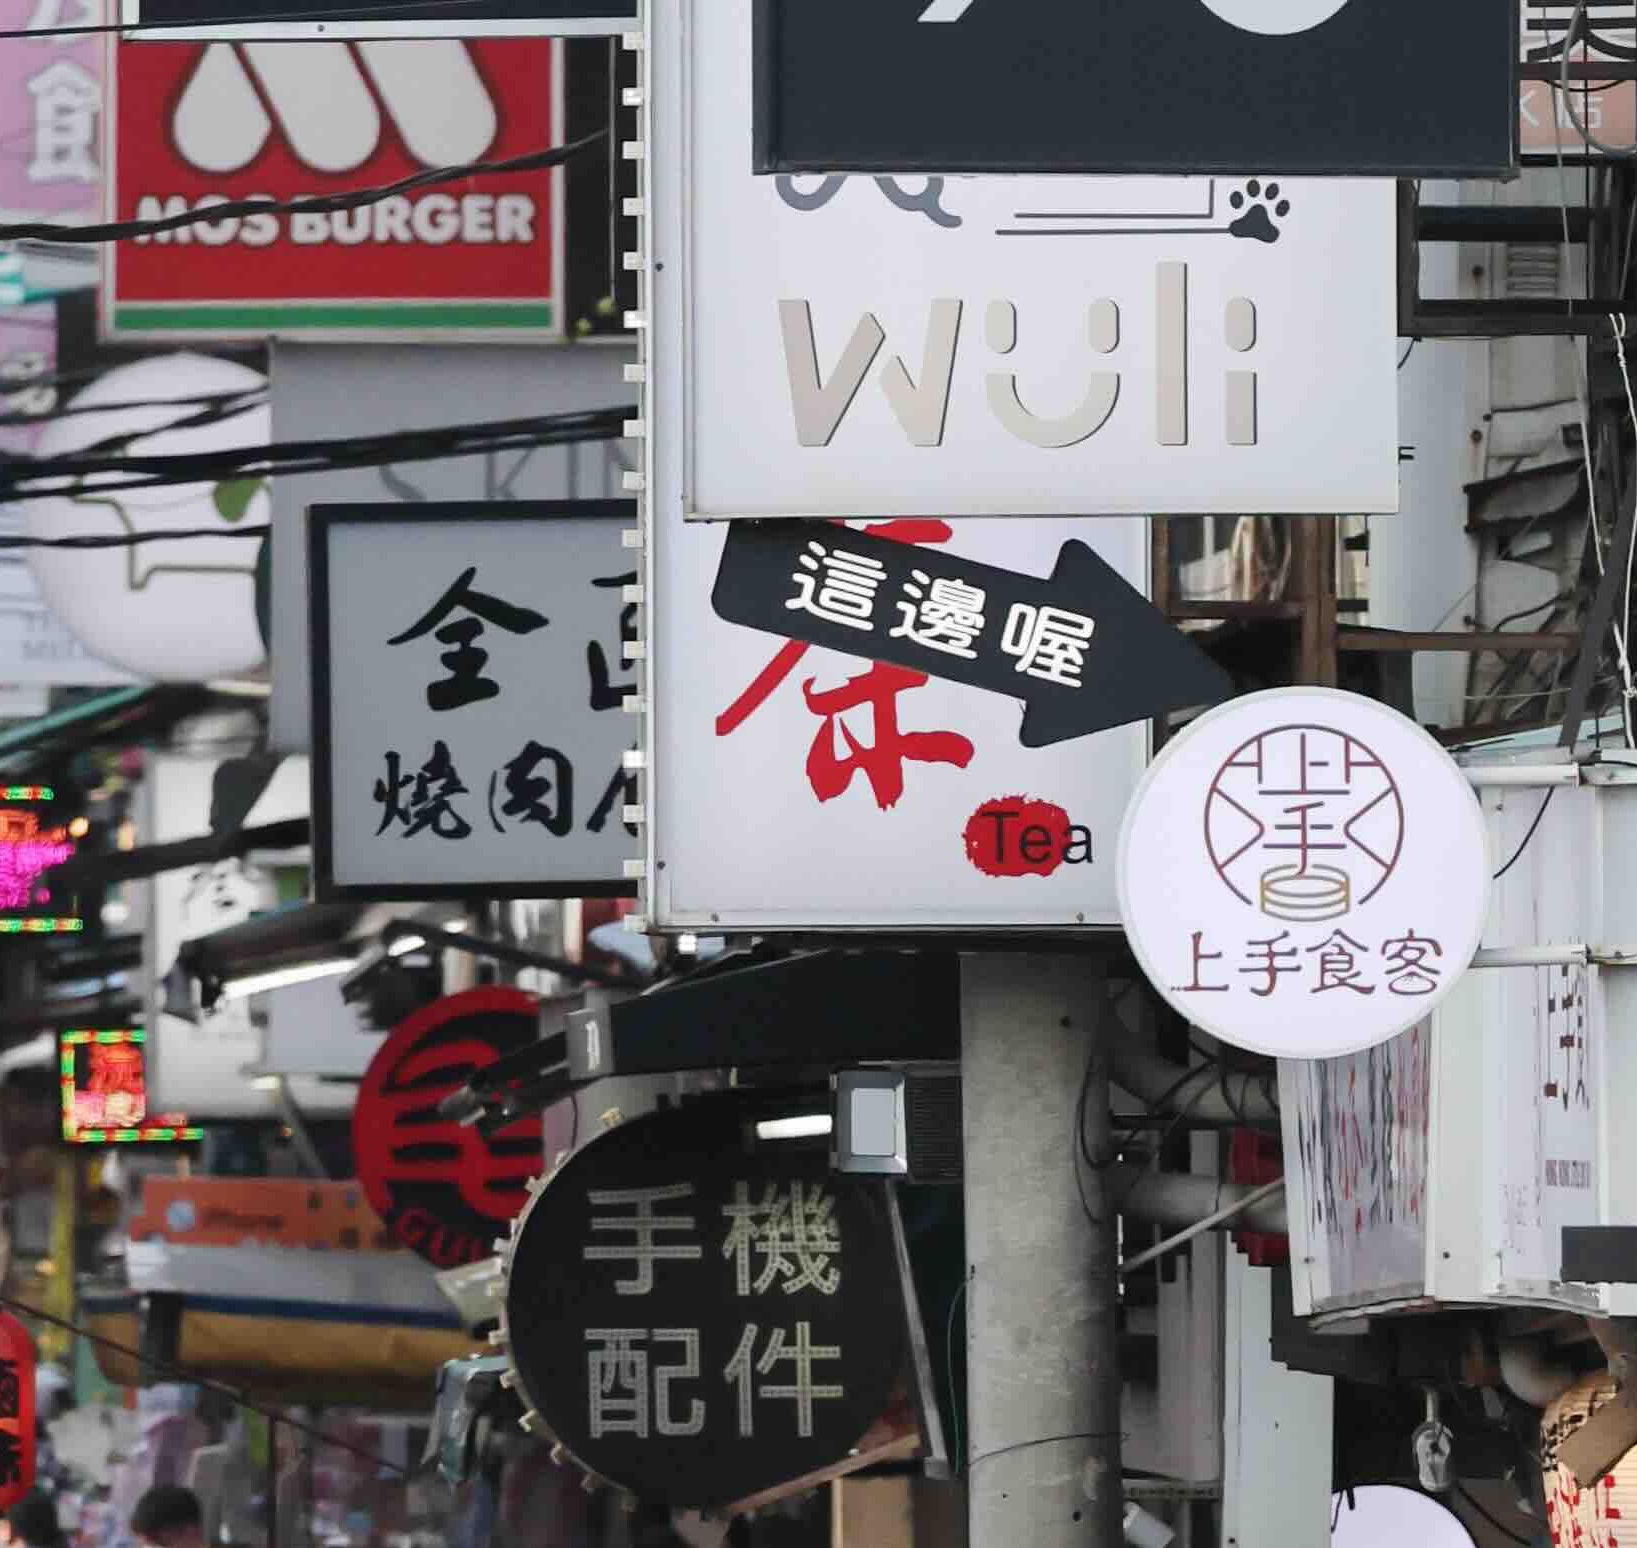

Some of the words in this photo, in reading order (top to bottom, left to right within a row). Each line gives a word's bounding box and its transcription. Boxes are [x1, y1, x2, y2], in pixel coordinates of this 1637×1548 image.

[134, 195, 279, 246] MOS
[289, 194, 536, 246] BURGER
[785, 541, 1095, 688] 這邊喔
[983, 810, 1094, 865] Tea
[1172, 928, 1443, 997] 上手食客
[582, 1179, 842, 1296] 手機
[583, 1321, 844, 1439] 配件
